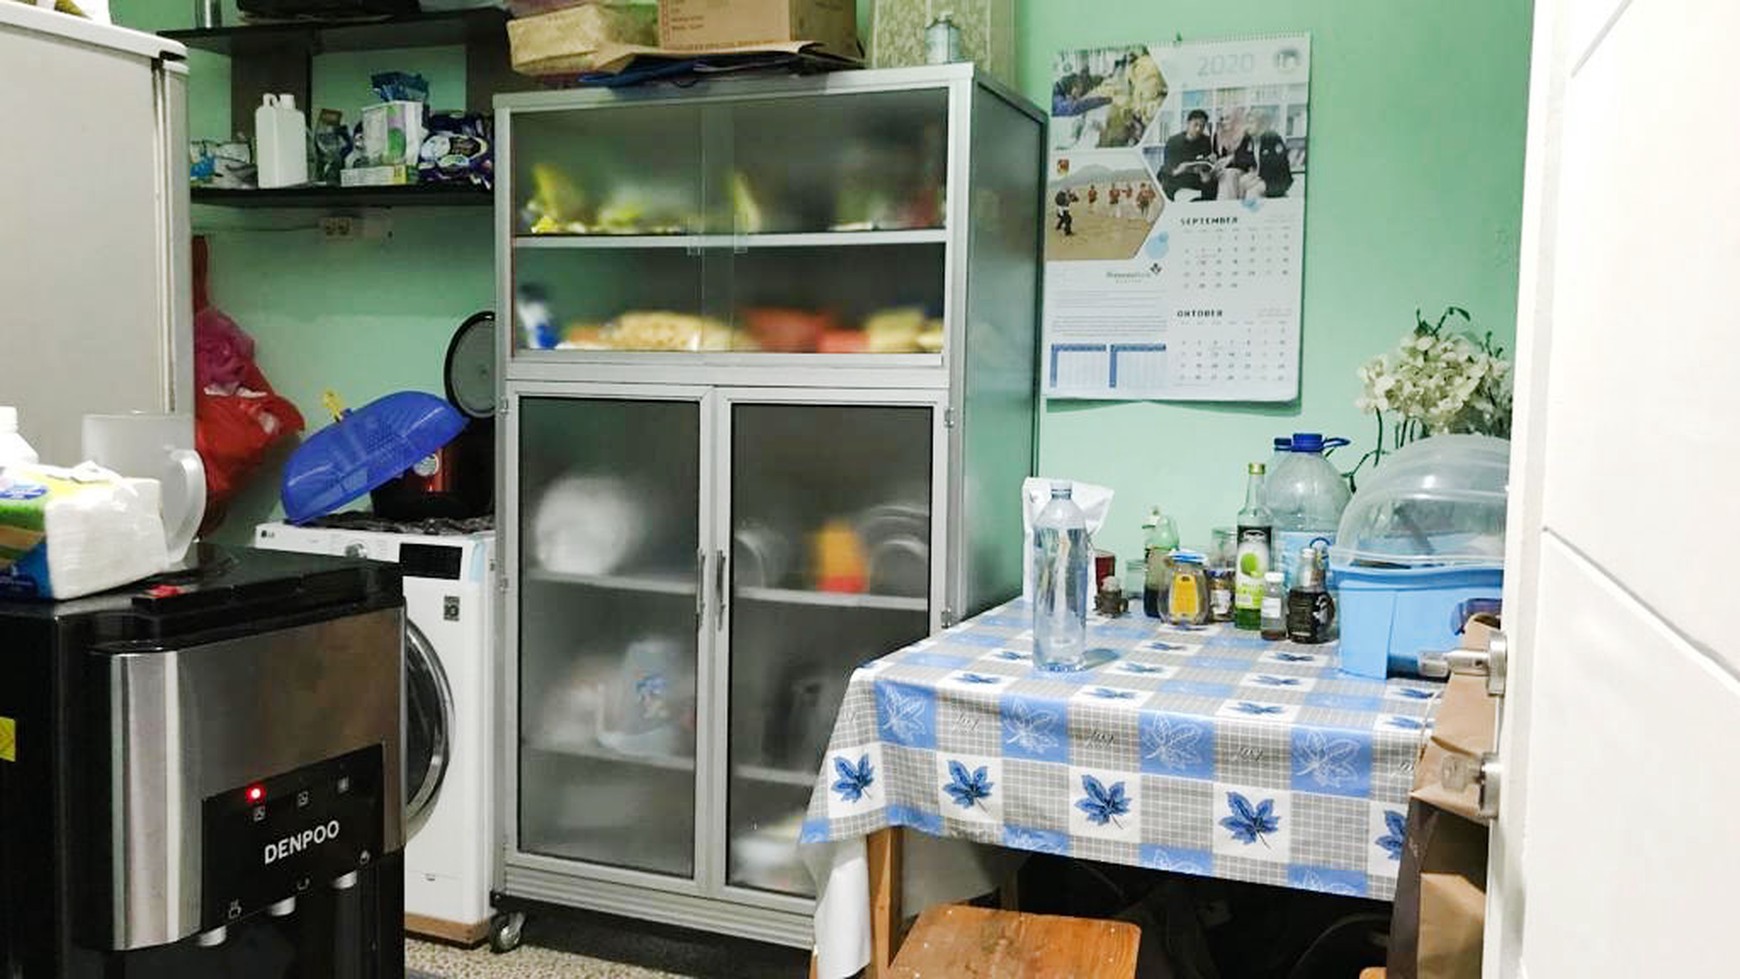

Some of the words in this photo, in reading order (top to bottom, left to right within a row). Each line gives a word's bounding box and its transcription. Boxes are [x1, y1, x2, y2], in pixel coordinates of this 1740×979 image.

[1197, 52, 1254, 77] 2020
[1180, 216, 1238, 226] SEPTEMBER
[1176, 309, 1223, 318] OKTOBER
[263, 819, 341, 866] DENPOO
